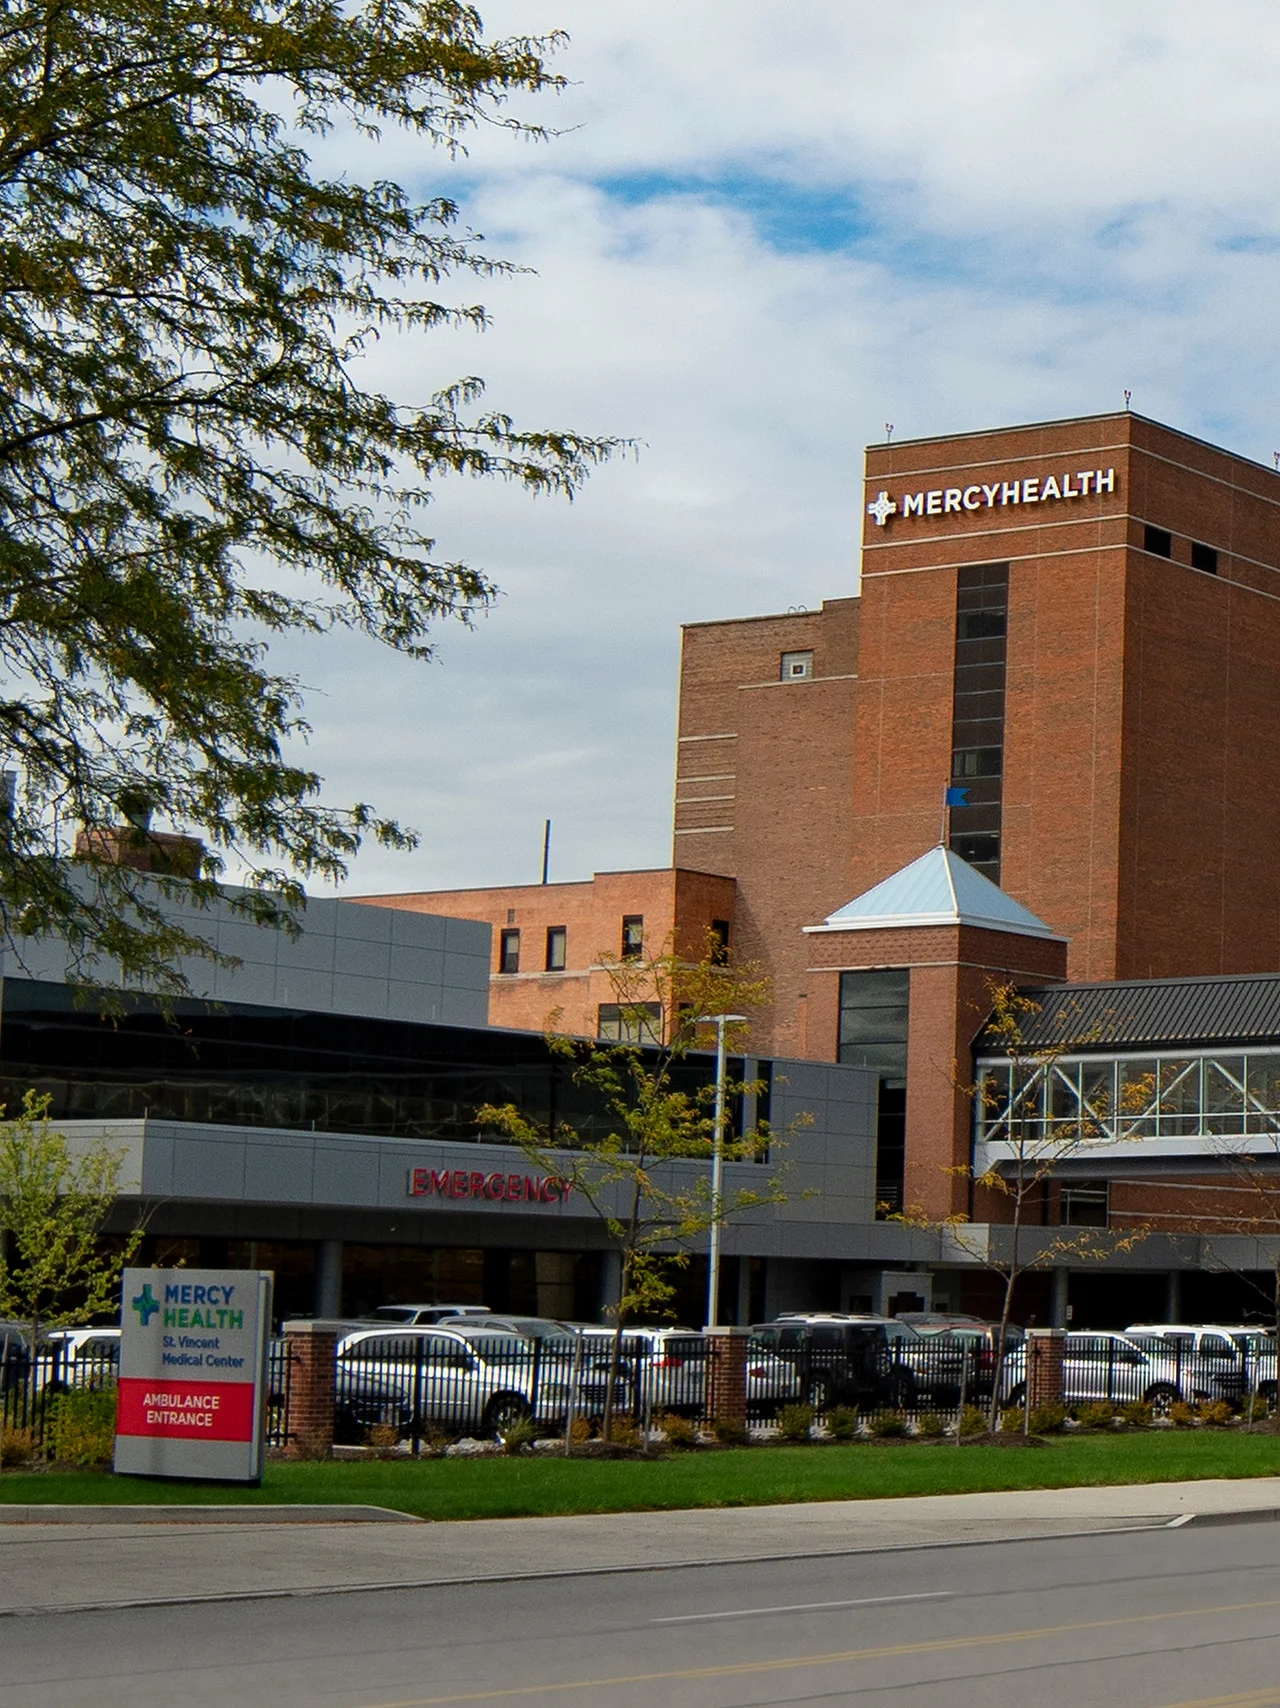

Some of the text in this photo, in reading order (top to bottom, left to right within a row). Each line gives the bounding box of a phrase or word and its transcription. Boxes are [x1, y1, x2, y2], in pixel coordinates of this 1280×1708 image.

[903, 468, 1115, 518] MERCYHEALTH
[409, 1168, 576, 1203] EMERGENCY
[165, 1284, 235, 1305] MERCY
[163, 1308, 244, 1330] HEALTH
[178, 1335, 220, 1349] Vincent
[162, 1353, 245, 1368] Medical Center
[142, 1393, 220, 1410] AMBULANCE
[146, 1410, 213, 1427] ENTRANCE
